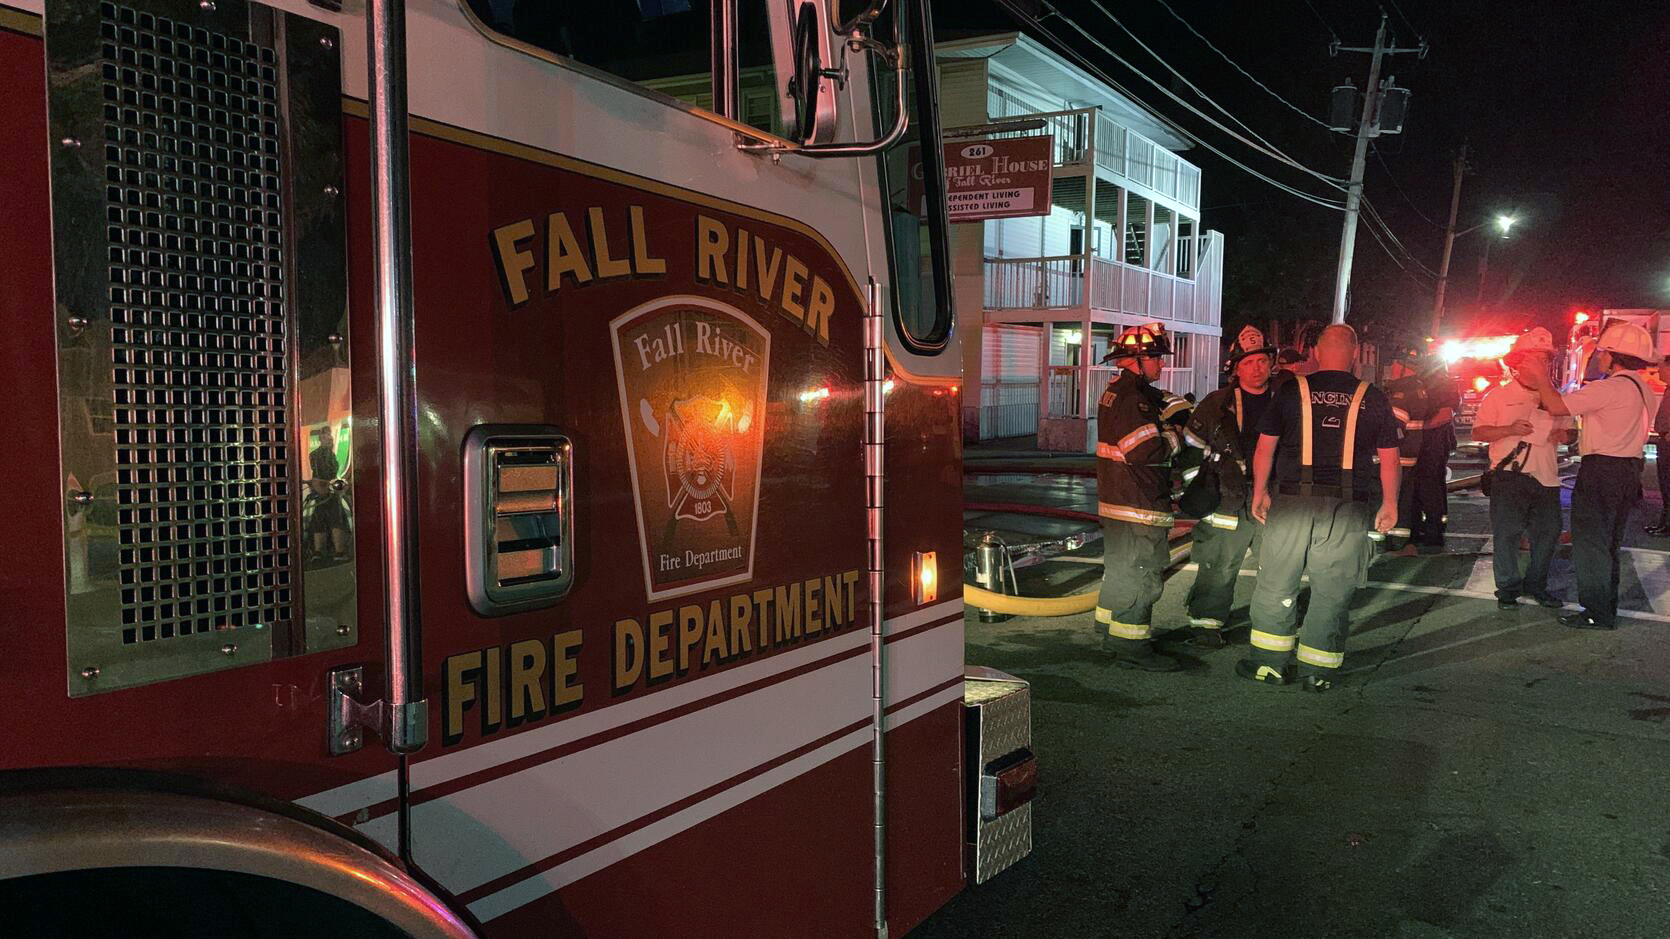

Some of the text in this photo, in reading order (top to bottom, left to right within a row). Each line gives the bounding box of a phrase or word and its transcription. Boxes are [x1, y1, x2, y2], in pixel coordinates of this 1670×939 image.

[969, 147, 986, 156] 261
[953, 175, 975, 187] Fall
[979, 173, 1011, 186] River
[992, 190, 1020, 199] LIVING
[948, 201, 1010, 211] SSISTED LIVING
[490, 205, 836, 344] FALL RIVER
[634, 321, 755, 374] Fall River
[694, 501, 712, 514] 1803
[660, 546, 742, 571] Fire Department
[443, 570, 859, 742] FIRE DEPARTMENT
